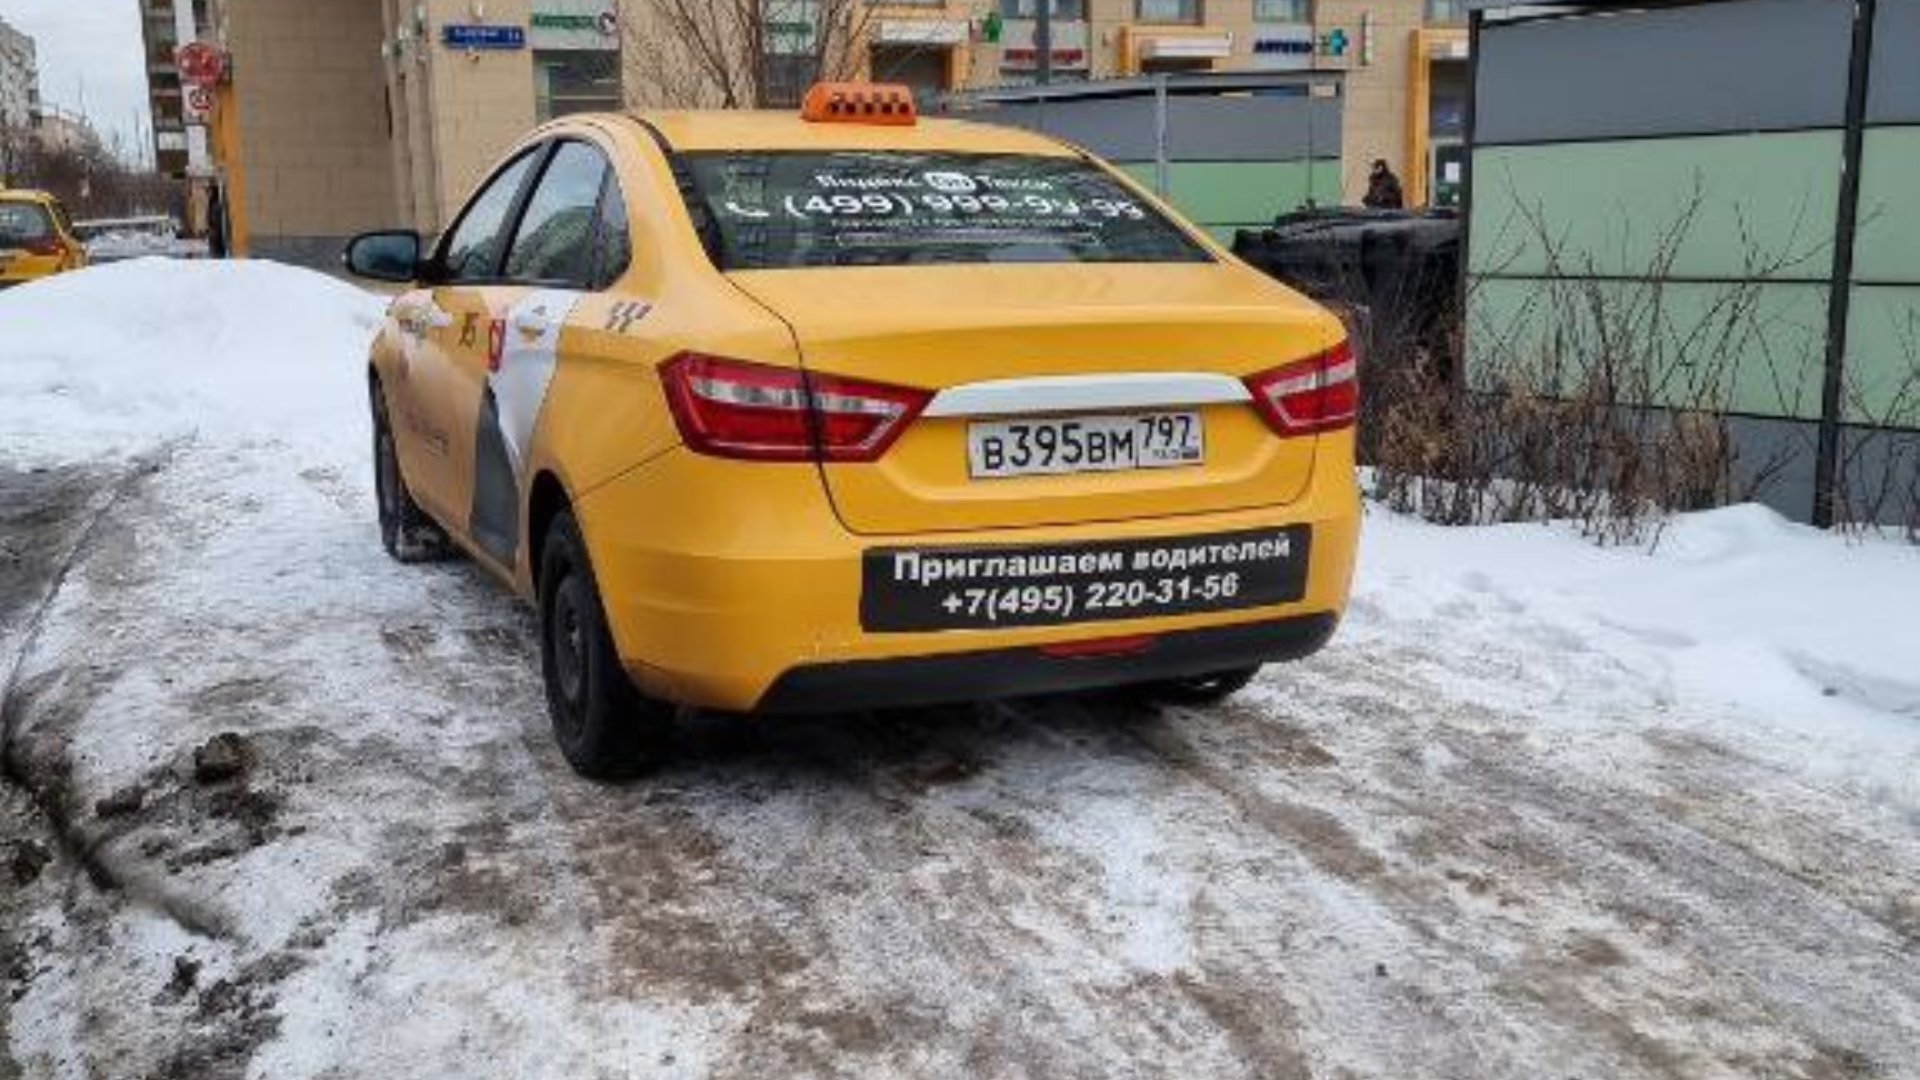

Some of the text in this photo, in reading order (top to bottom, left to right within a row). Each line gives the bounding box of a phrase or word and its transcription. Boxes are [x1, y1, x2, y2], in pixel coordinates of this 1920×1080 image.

[784, 194, 913, 219] (499)
[982, 415, 1192, 470] В395ВМ 797
[894, 532, 1290, 587] Приглашаем водителей
[942, 573, 1240, 621] +7(495) 220-31-56
